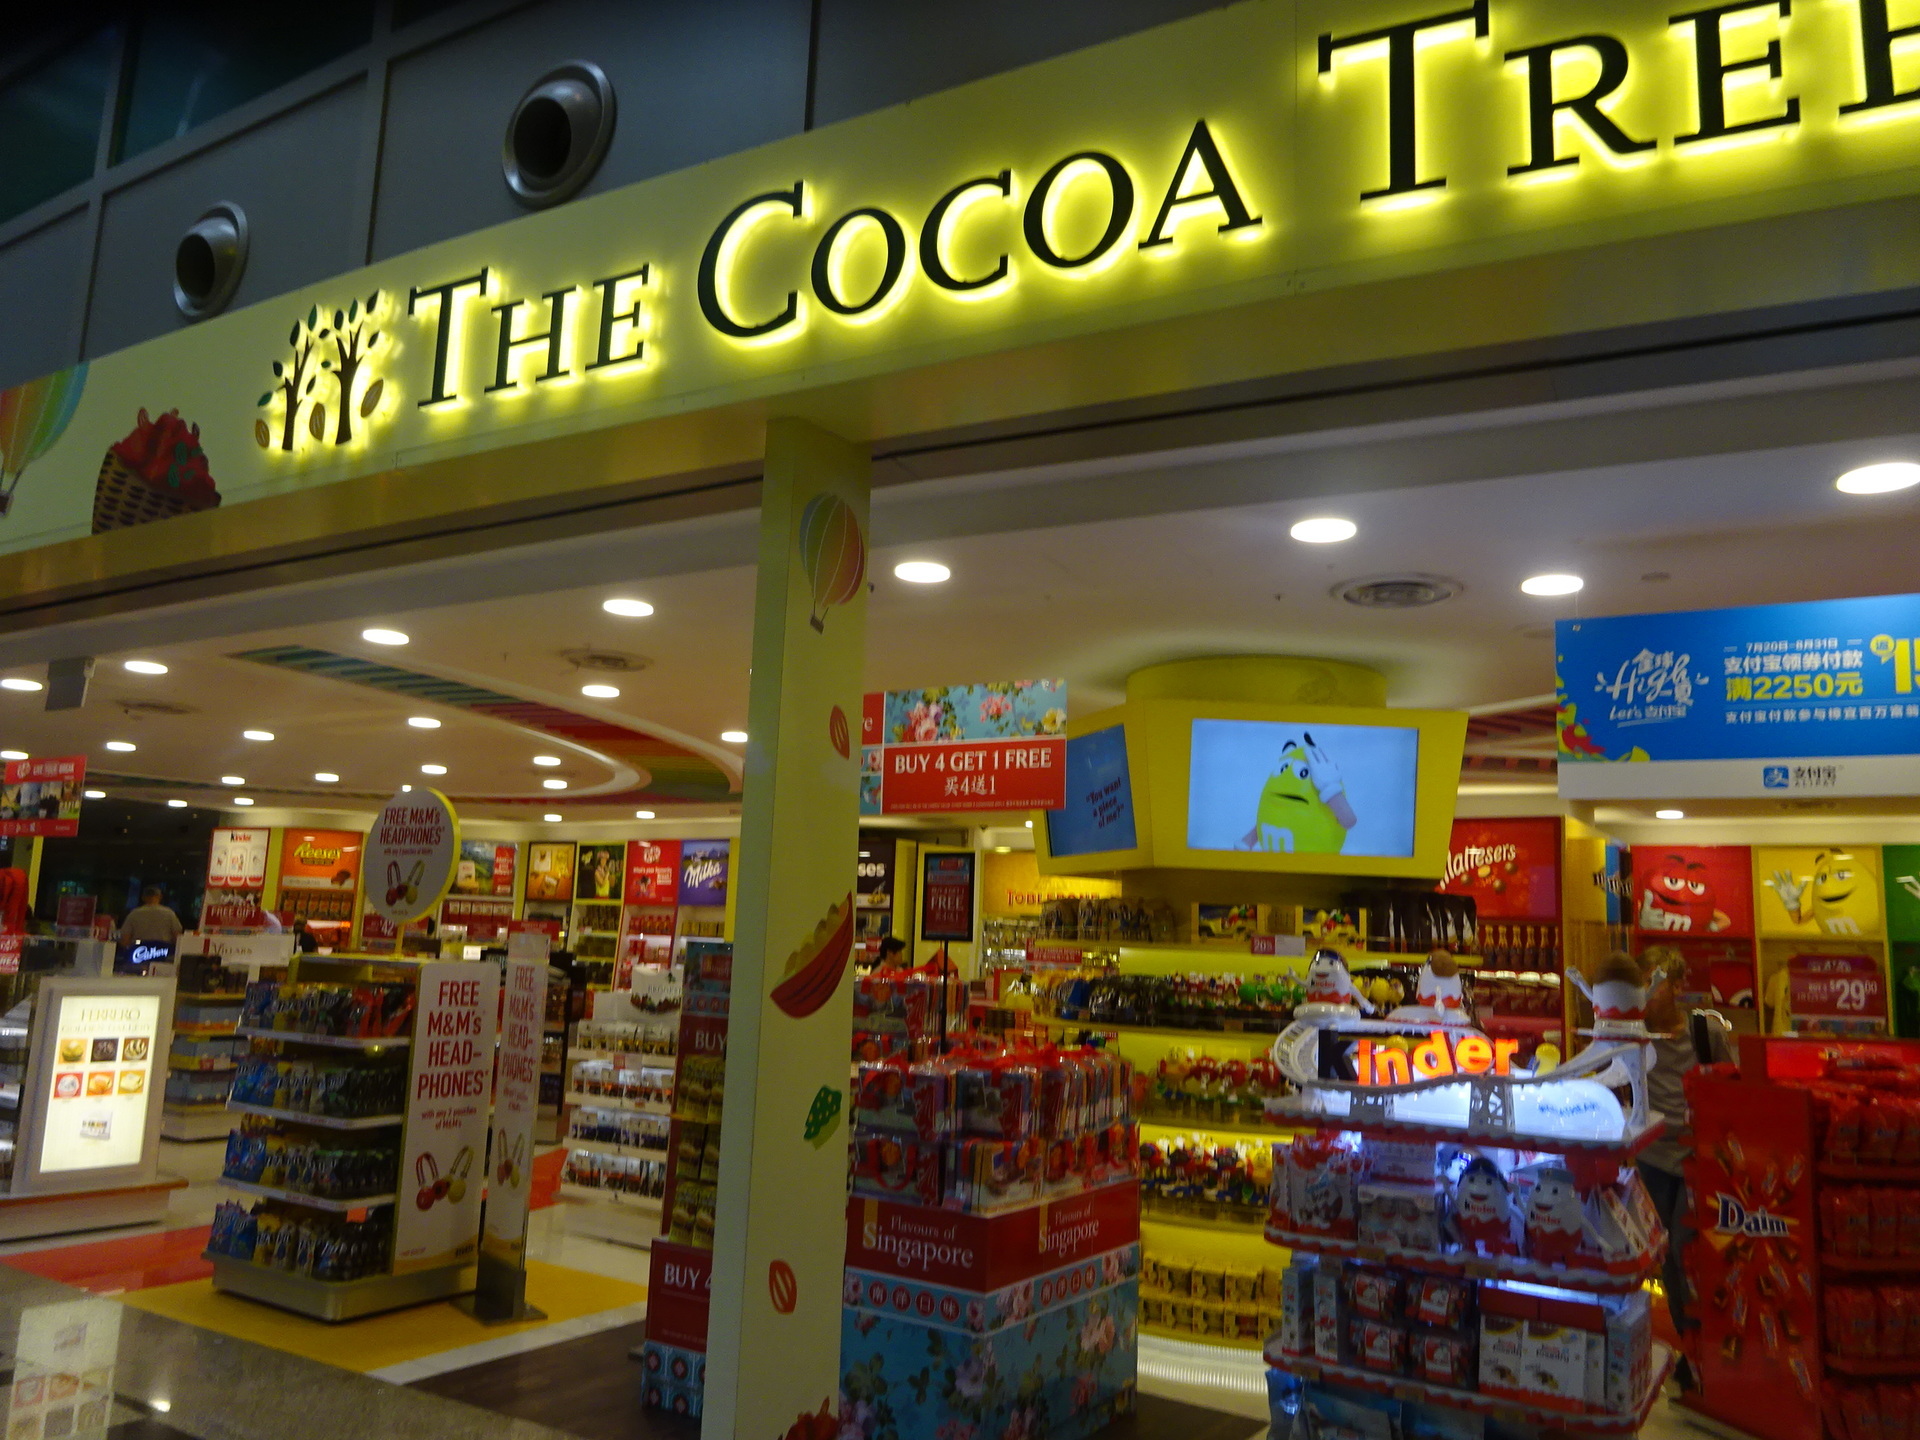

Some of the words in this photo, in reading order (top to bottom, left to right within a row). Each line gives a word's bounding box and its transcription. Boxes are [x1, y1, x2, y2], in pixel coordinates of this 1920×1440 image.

[408, 262, 650, 409] THE
[697, 118, 1263, 338] COCOA
[1726, 672, 1864, 701] 满2250元
[895, 753, 930, 774] BUY
[934, 752, 945, 772] 4
[950, 750, 987, 772] GET
[993, 750, 999, 770] 1
[1005, 747, 1052, 769] FREE
[944, 773, 996, 797] 买4送1
[384, 807, 408, 826] FREE
[684, 860, 722, 888] Milka
[211, 906, 233, 917] FREE
[931, 896, 963, 911] FREE
[515, 965, 535, 991] FREE
[439, 980, 480, 1007] FREE
[81, 1008, 141, 1021] FERRERO
[427, 1010, 482, 1037] M&M's
[508, 1022, 533, 1050] HEAD-
[695, 1029, 728, 1051] BUY
[428, 1039, 482, 1068] HEAD-
[1055, 1209, 1082, 1225] Flavours
[1084, 1204, 1091, 1218] of
[1716, 1190, 1789, 1237] Daim
[891, 1214, 939, 1237] Flavours
[943, 1224, 957, 1241] of
[1039, 1218, 1099, 1258] Singapore
[863, 1221, 974, 1271] Singapore
[664, 1262, 700, 1290] BUY
